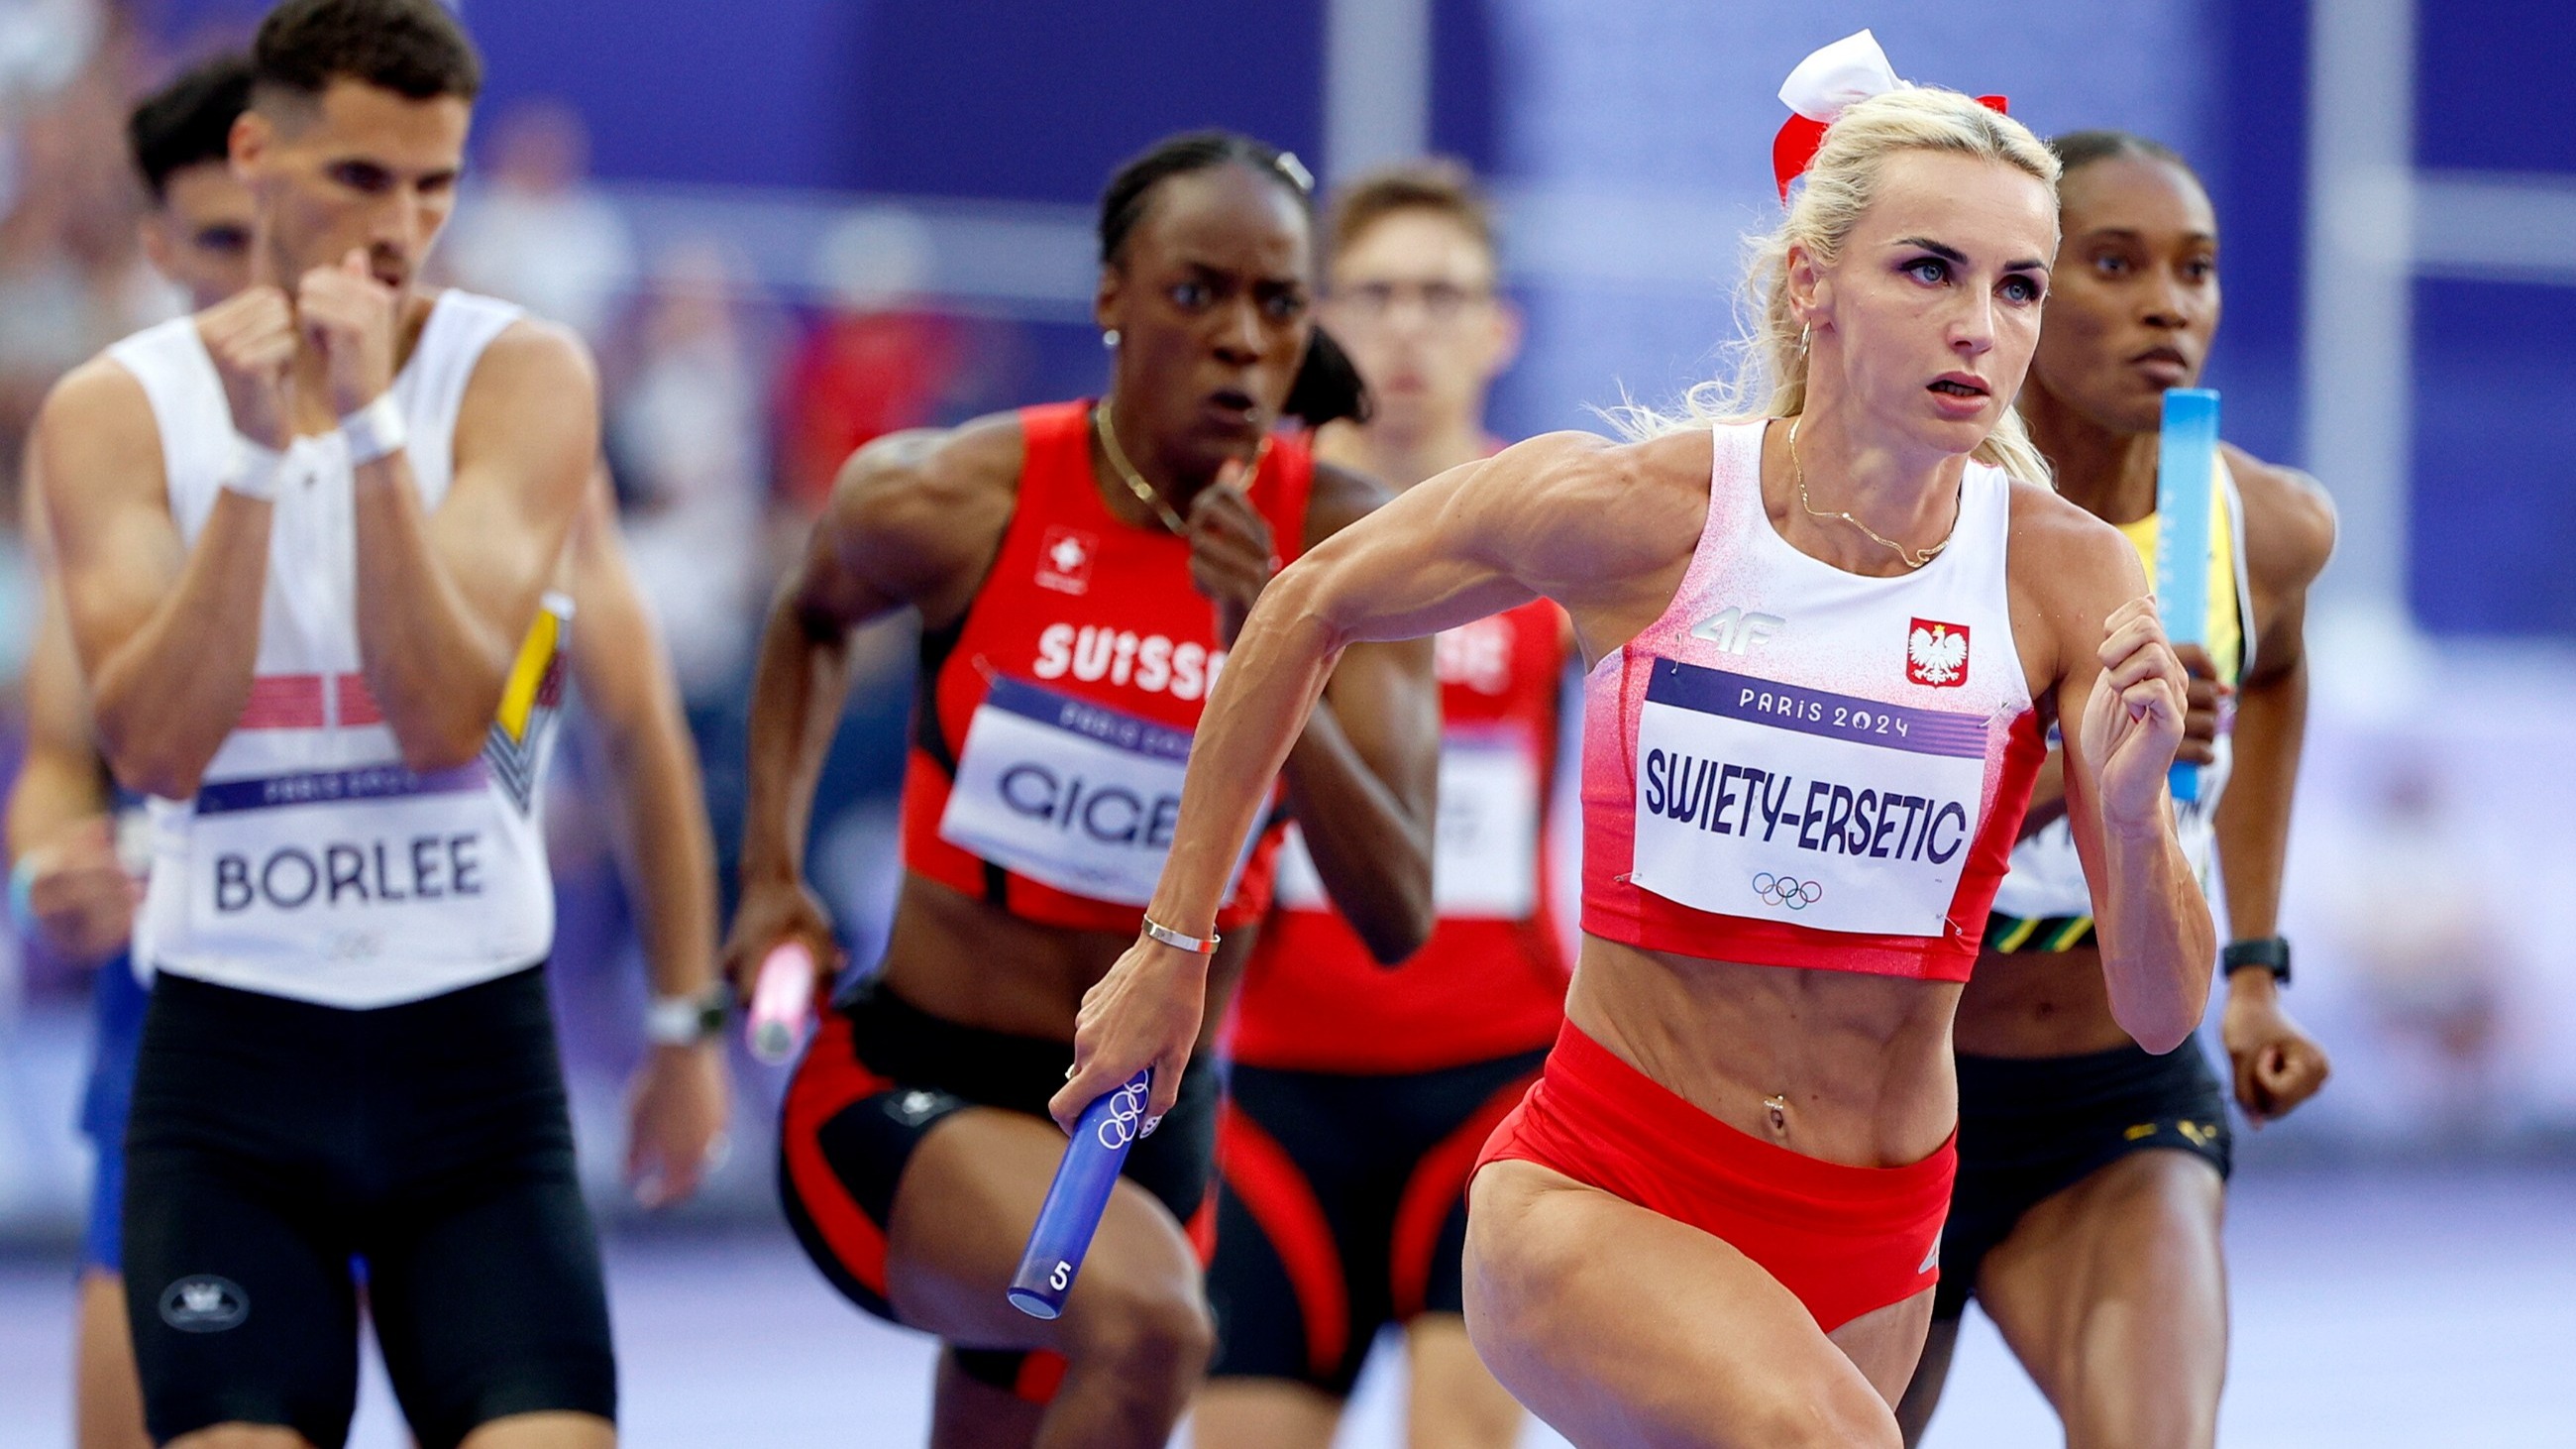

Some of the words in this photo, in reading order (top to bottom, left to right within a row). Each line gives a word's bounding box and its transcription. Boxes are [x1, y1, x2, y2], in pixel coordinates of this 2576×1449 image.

[1690, 606, 1785, 656] 4F
[1833, 707, 1908, 737] 2024
[1646, 748, 1967, 864] SWIETY-ERSETIC
[215, 833, 482, 914] BORLEE
[1049, 1260, 1072, 1290] 5
